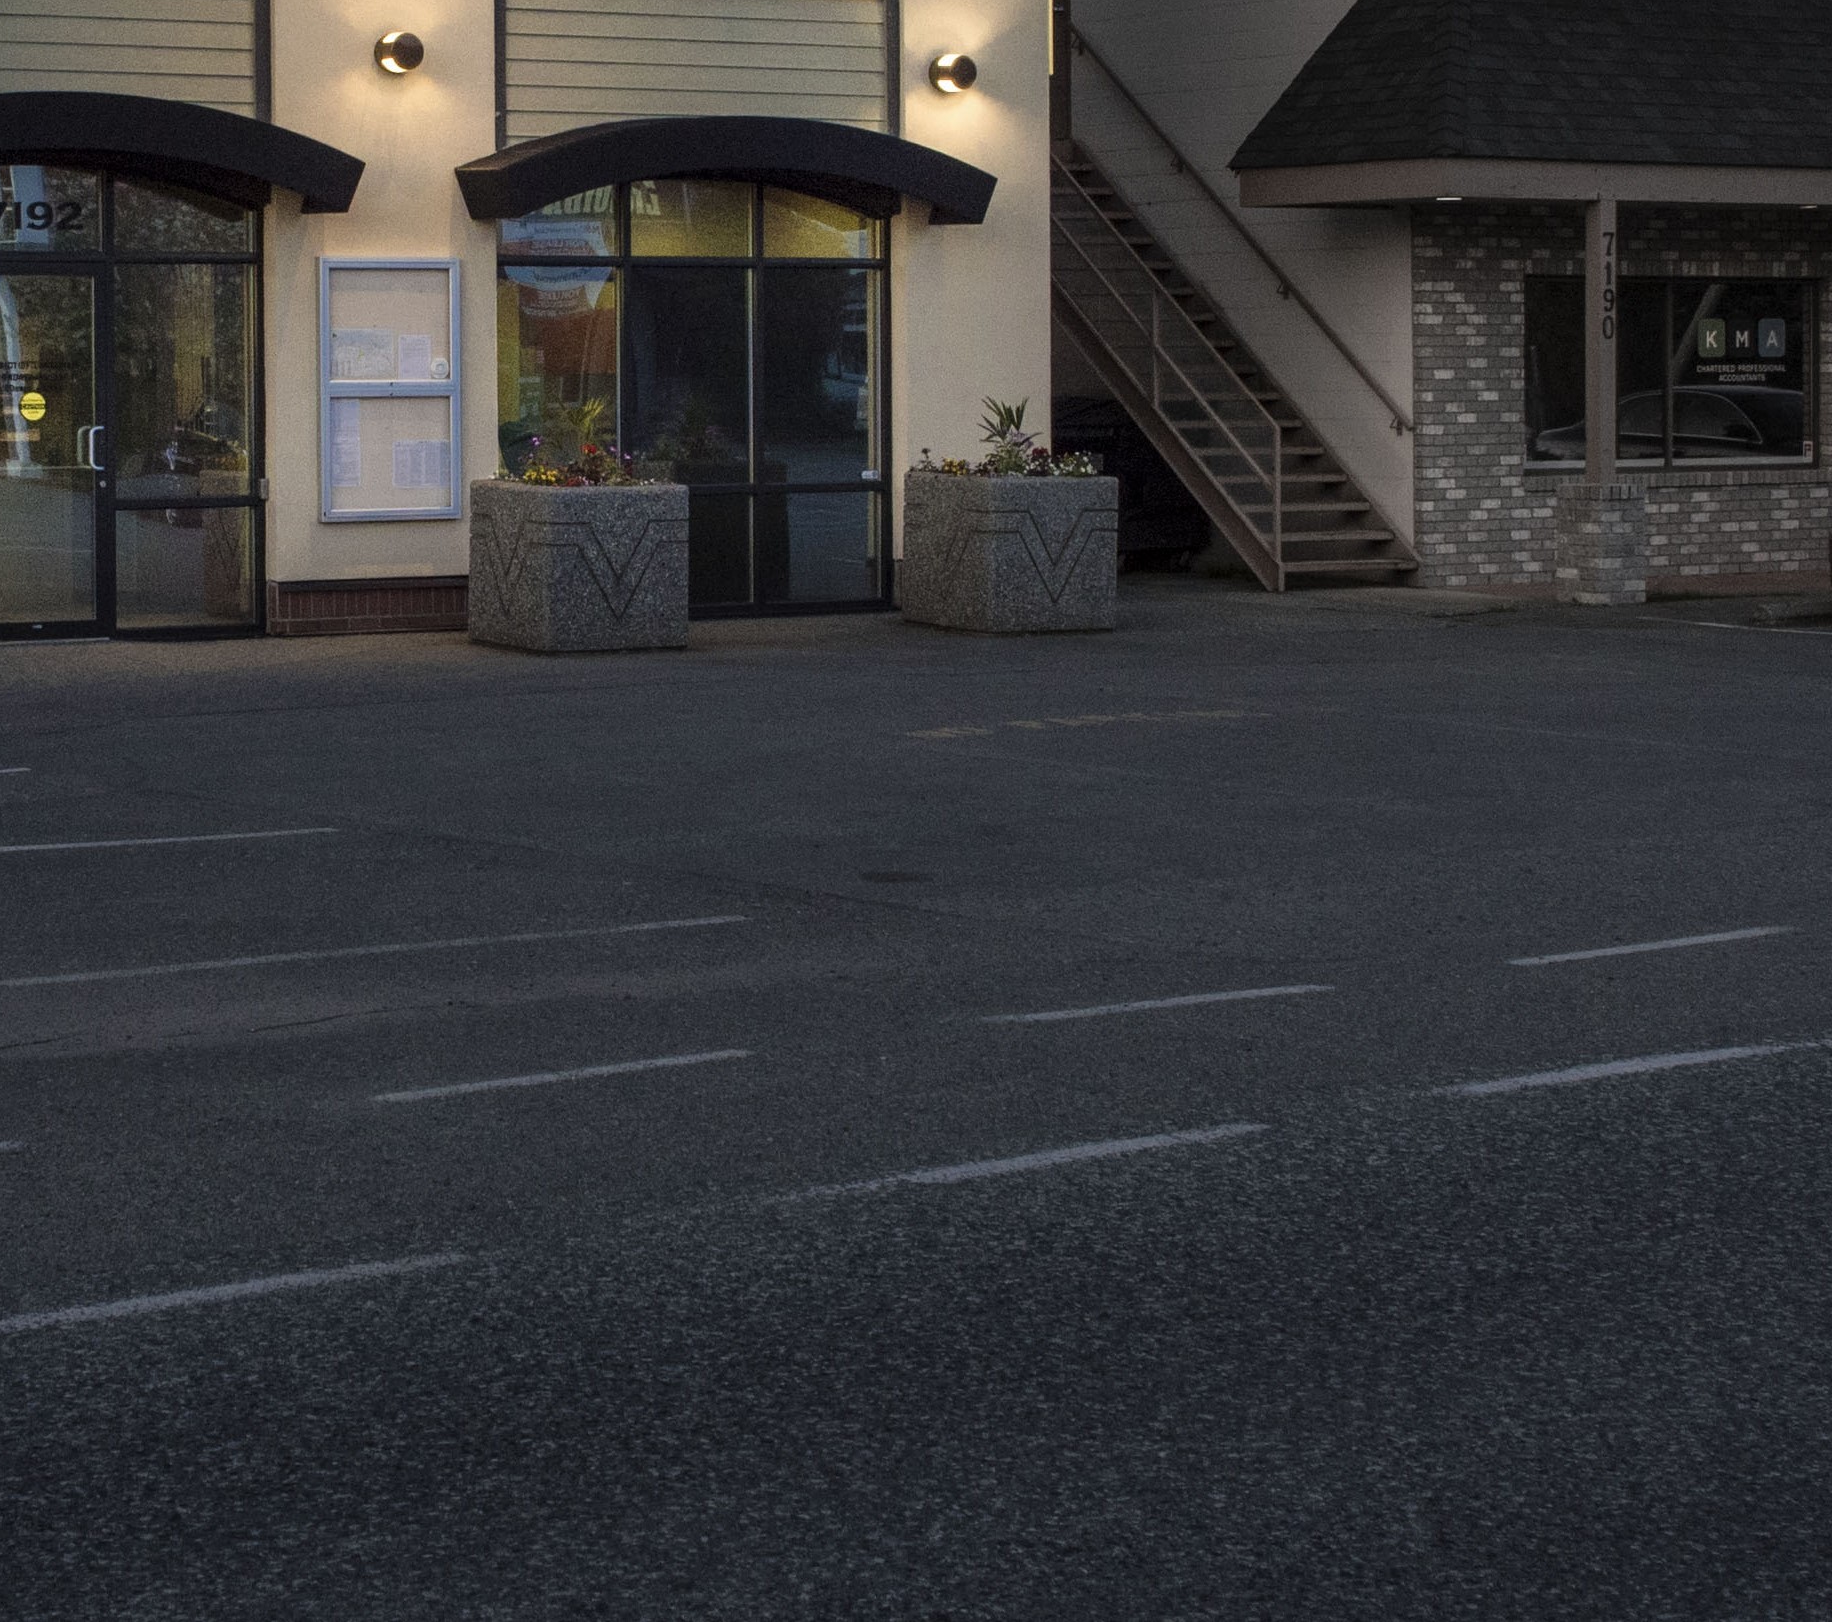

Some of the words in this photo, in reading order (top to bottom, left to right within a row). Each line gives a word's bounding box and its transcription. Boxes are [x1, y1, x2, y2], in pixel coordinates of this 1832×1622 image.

[1602, 231, 1615, 339] 7190
[1696, 364, 1735, 373] CHARTERED
[1738, 364, 1786, 373] PROFESSIONAL
[1718, 373, 1766, 382] ACCOUNTANTS
